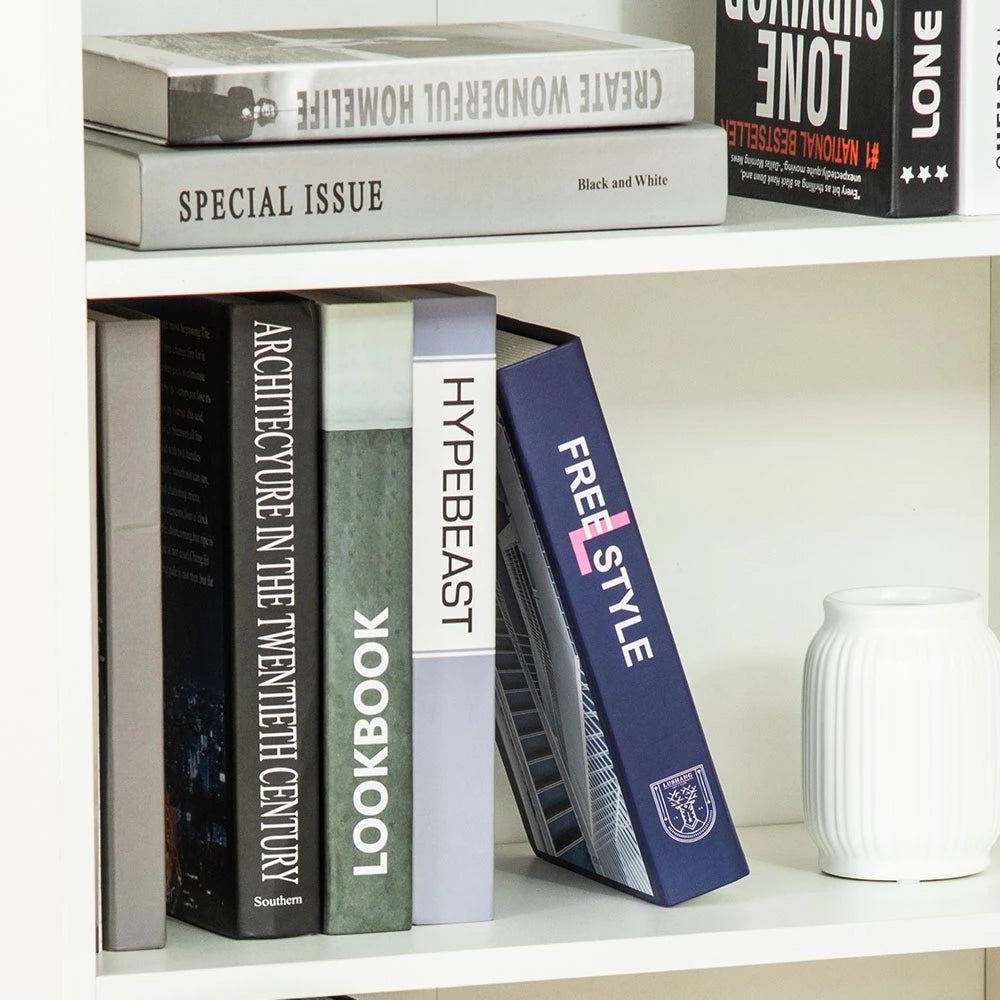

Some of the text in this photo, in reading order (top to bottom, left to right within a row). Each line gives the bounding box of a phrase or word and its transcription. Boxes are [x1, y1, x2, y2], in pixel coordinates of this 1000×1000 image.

[756, 29, 851, 131] LONE
[911, 10, 943, 139] LONE
[296, 67, 663, 130] CREATE WONDERFUL HOMELIFE
[800, 130, 858, 166] NATIONAL
[865, 141, 880, 170] #1
[578, 173, 668, 192] Black and White
[753, 172, 767, 184] Down
[767, 174, 780, 186] Hawk
[781, 177, 793, 189] Black
[794, 179, 801, 187] as
[802, 178, 824, 194] thrilling
[824, 184, 831, 193] as
[832, 186, 841, 197] bit
[179, 180, 384, 223] SPECIAL ISSUE
[441, 377, 475, 633] HYPEBEAST
[557, 436, 654, 668] FREE STYLE
[254, 320, 299, 885] ARCHITECYURE IN THE TWENTIETH CENTURY
[353, 607, 390, 876] LOOKBOOK
[254, 895, 303, 907] Southern
